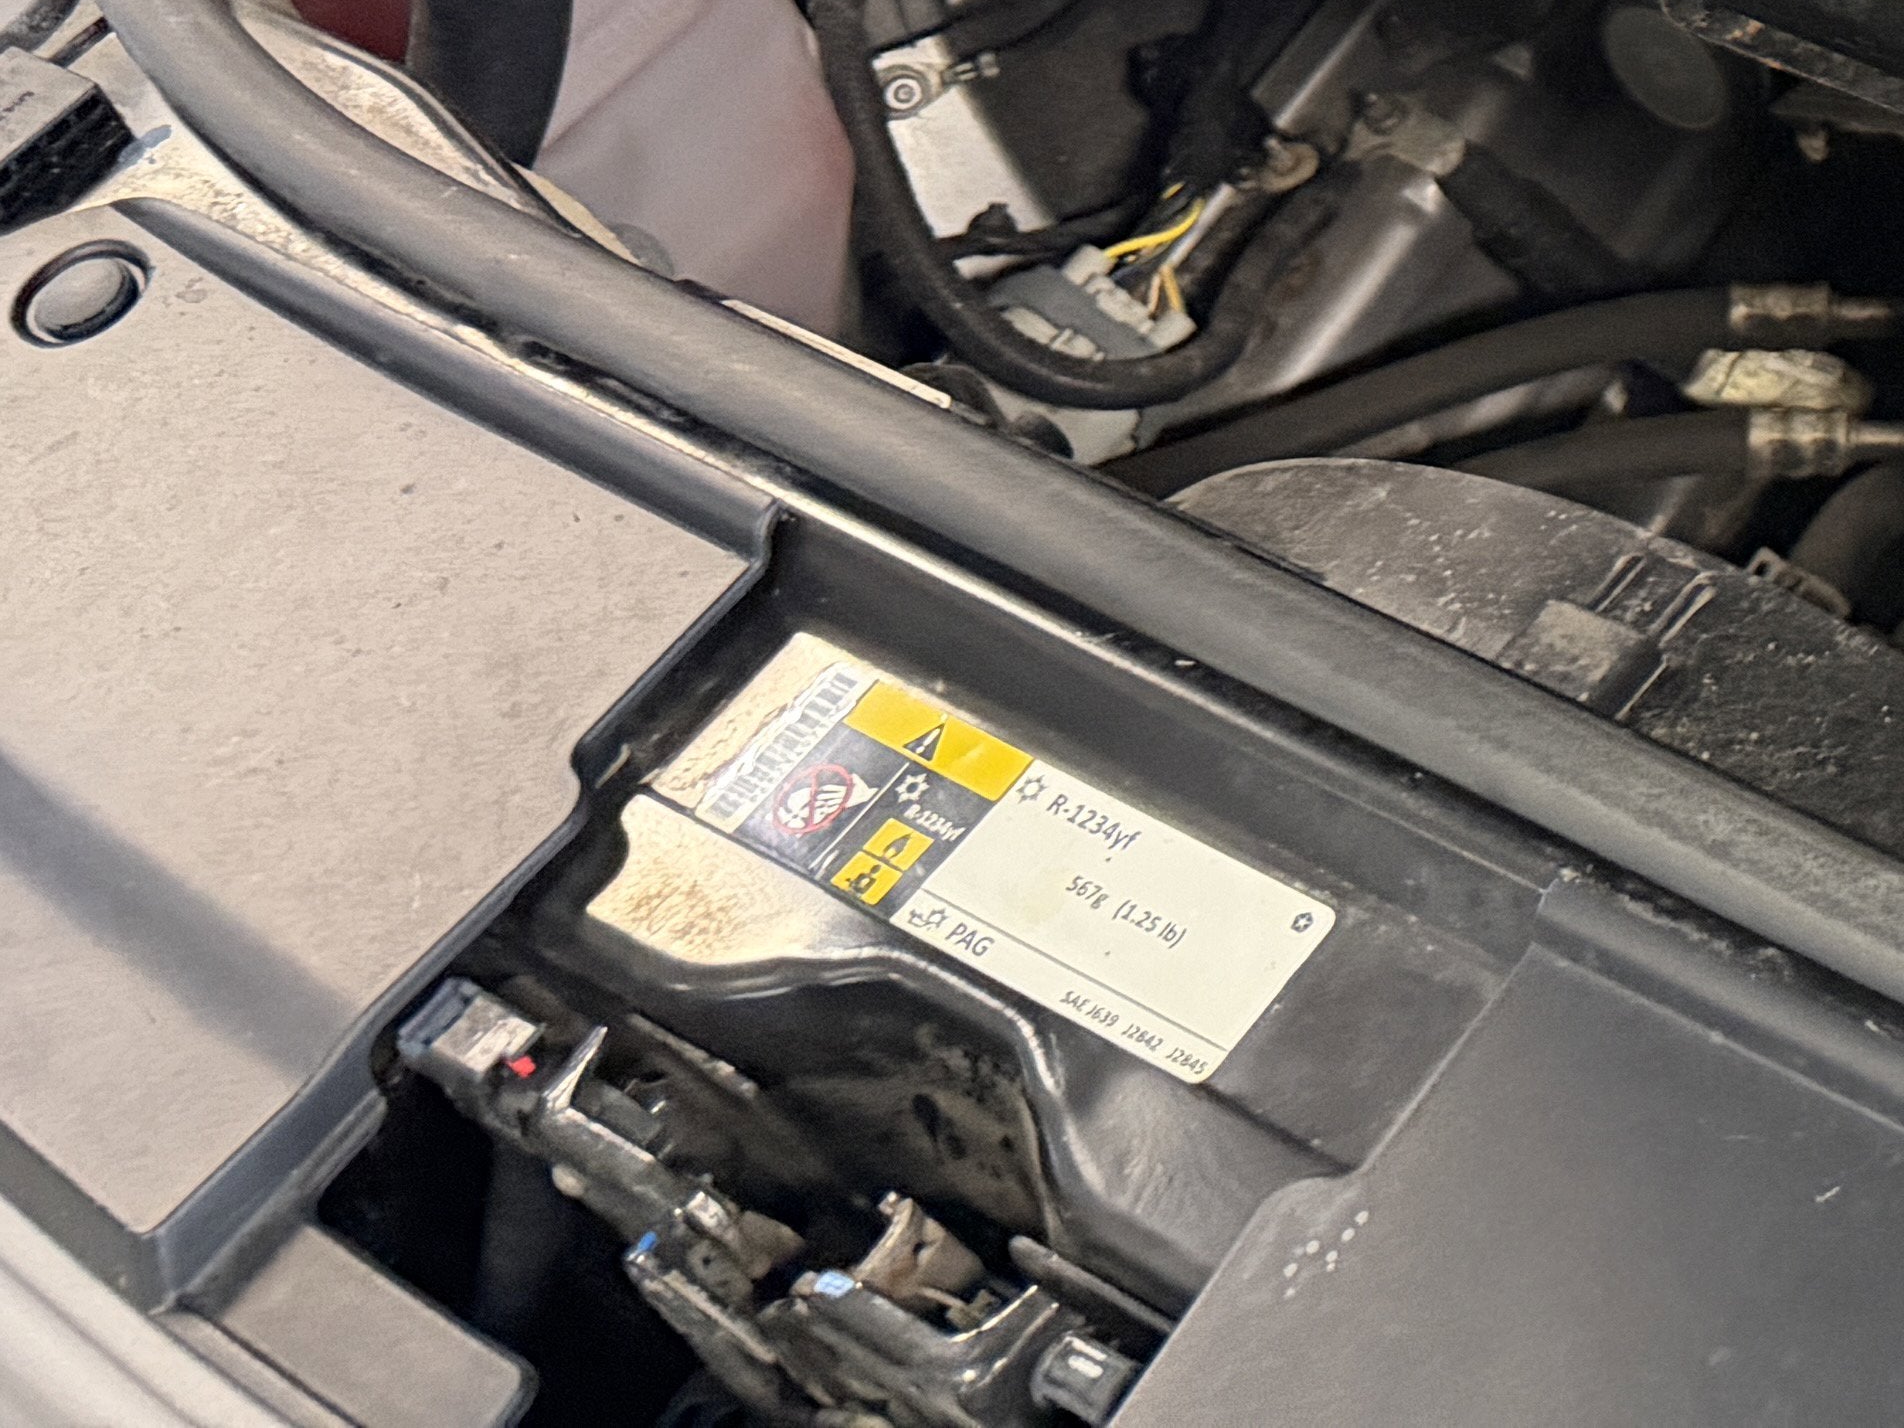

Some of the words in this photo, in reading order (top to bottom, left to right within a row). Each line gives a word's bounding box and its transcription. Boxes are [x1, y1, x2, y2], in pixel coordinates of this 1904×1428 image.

[1046, 792, 1142, 853] R-1234yf
[1065, 874, 1110, 911] 567g
[1112, 898, 1162, 934] (1.25
[944, 918, 997, 959] PAG
[1059, 990, 1090, 1012] SAE
